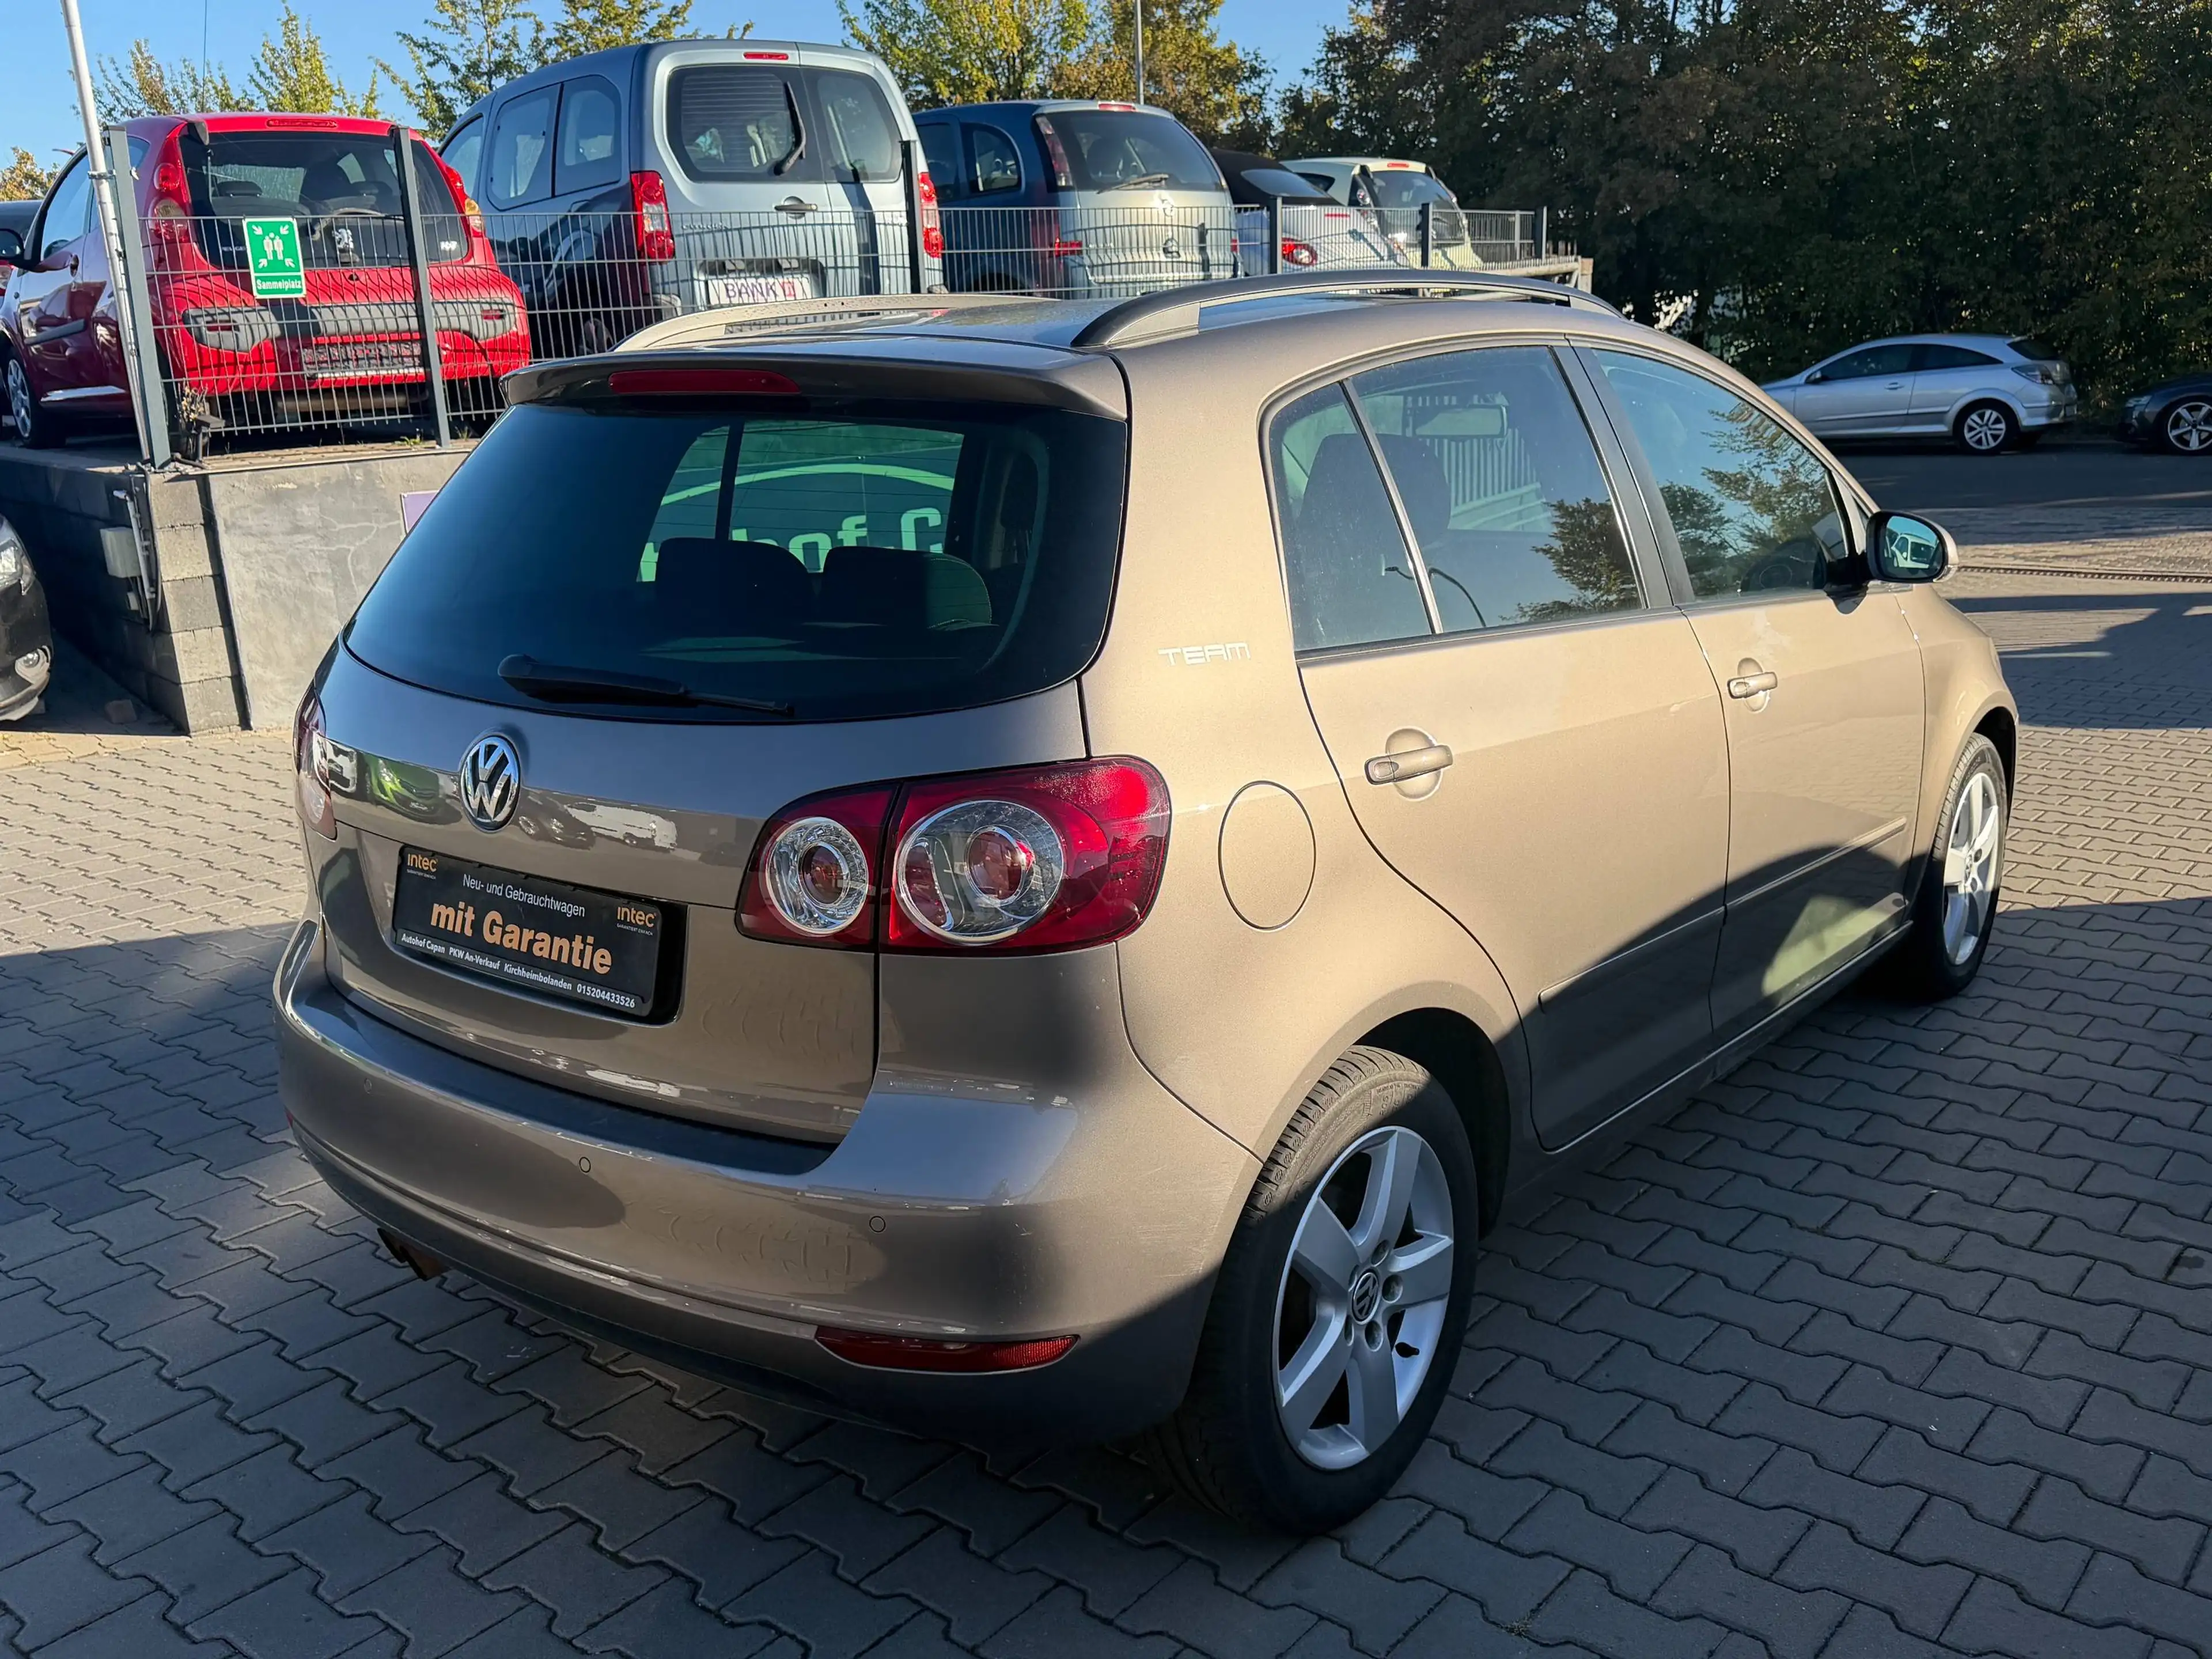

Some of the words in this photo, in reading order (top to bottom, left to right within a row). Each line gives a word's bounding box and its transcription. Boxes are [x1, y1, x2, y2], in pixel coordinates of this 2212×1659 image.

[256, 279, 302, 291] Sammelplatz
[1158, 642, 1251, 666] TEAM
[463, 874, 484, 890] Neu-
[486, 883, 503, 896] und
[505, 885, 585, 917] Gebrauchtwagen
[431, 902, 475, 937] mit
[483, 910, 612, 975] Garantie
[402, 934, 426, 948] Autohof
[426, 941, 445, 953] Capan
[449, 946, 464, 959] PKW
[464, 952, 501, 969] An-Verkauf
[504, 963, 572, 990] Kirchheimbolanden
[577, 983, 635, 1008] 015204433526
